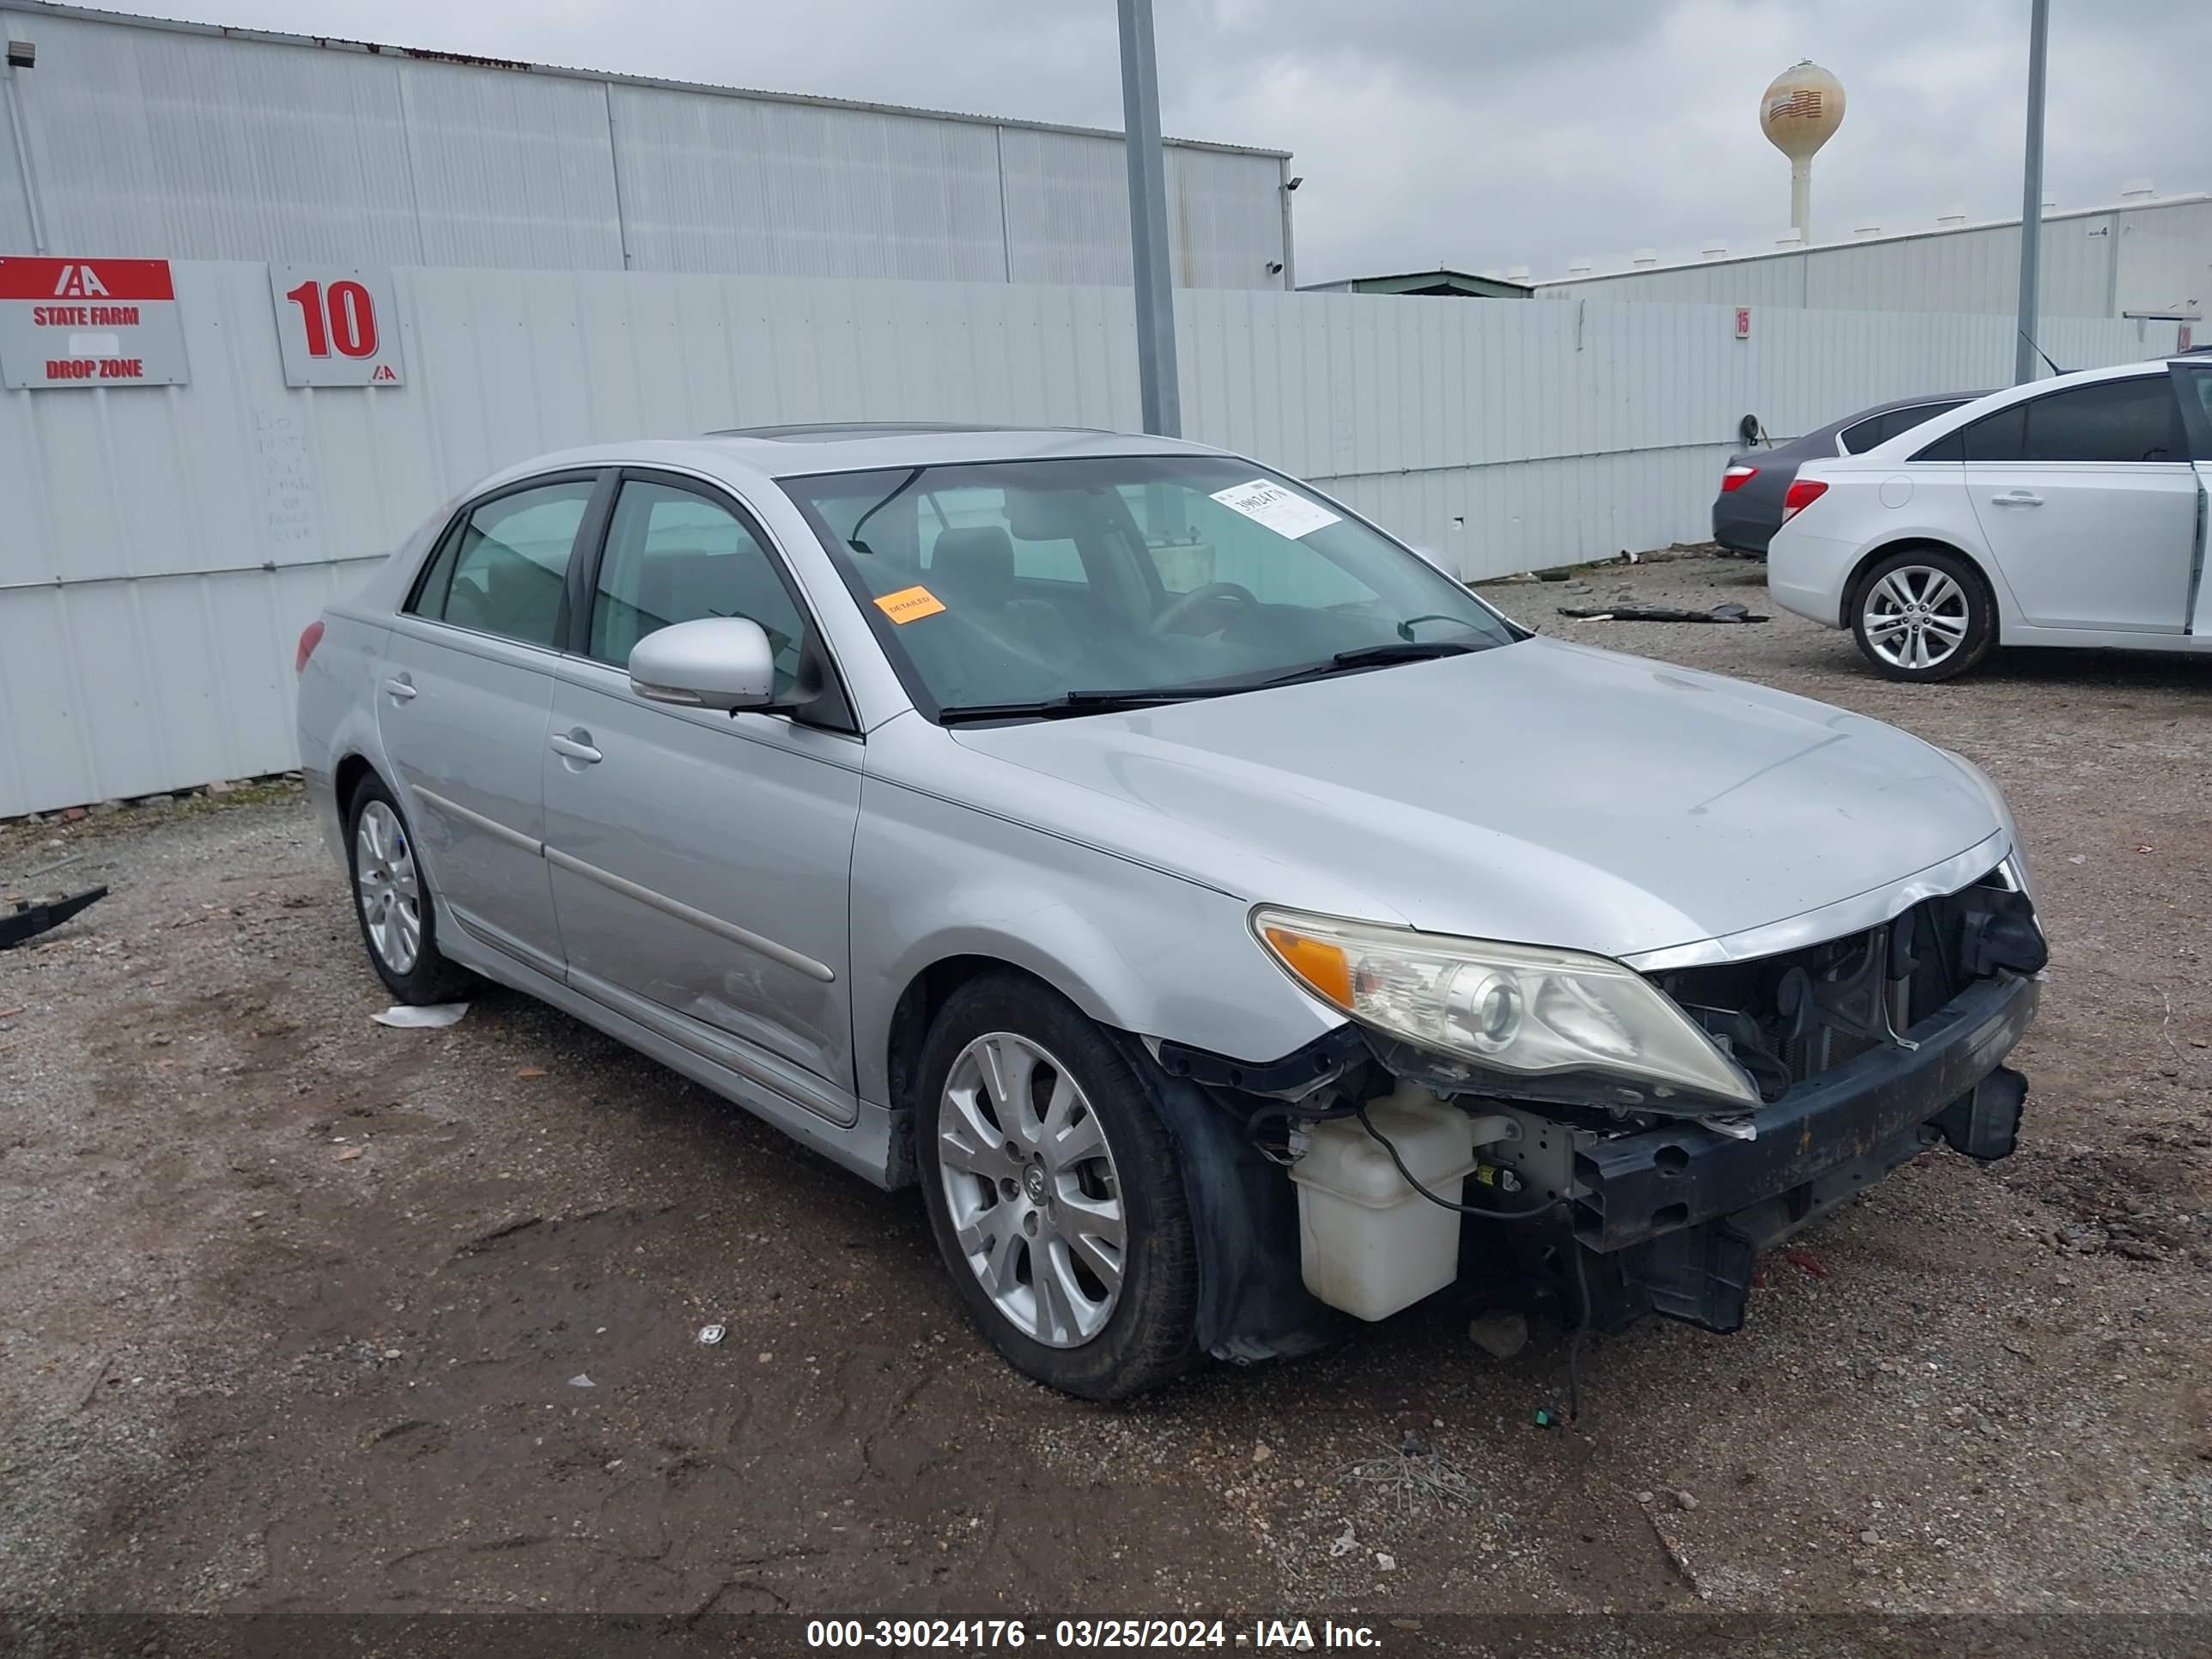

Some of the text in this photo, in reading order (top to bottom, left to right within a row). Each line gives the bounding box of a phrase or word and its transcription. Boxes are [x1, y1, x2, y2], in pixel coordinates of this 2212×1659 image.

[33, 306, 140, 326] STATE FARM
[286, 280, 379, 360] 10
[1737, 310, 1749, 333] 15
[46, 358, 143, 380] DROP ZONE
[889, 597, 930, 613] DETAILED
